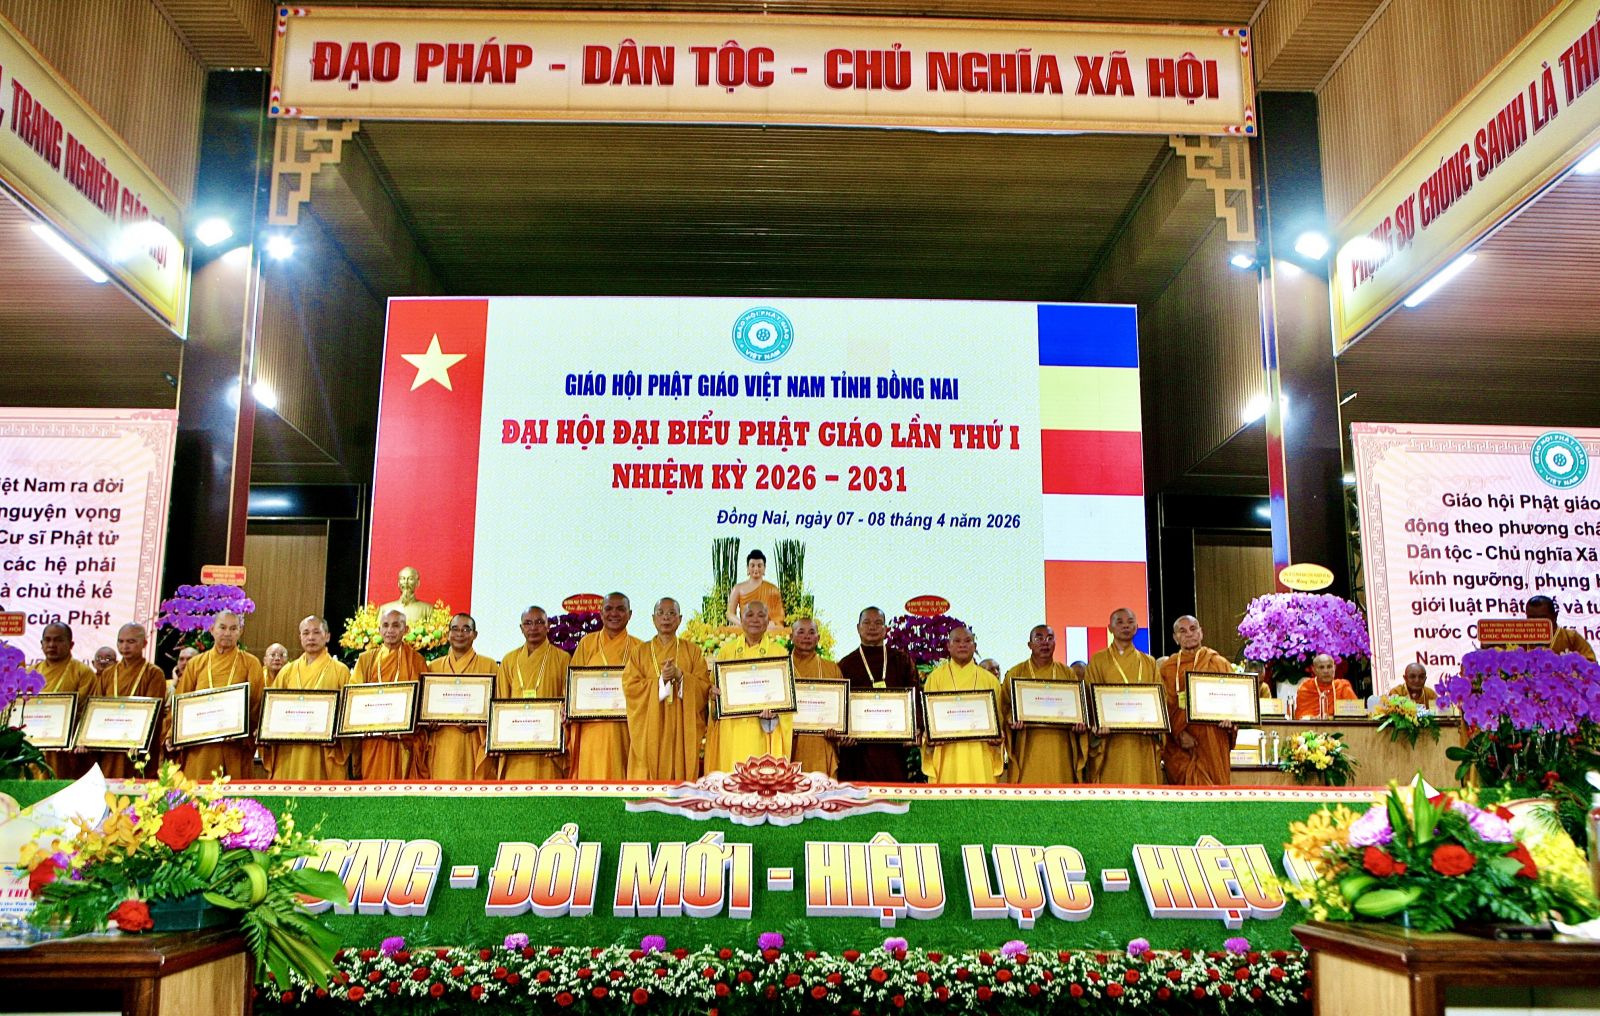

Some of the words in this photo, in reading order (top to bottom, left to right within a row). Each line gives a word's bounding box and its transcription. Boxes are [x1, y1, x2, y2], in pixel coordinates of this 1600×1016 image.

[310, 41, 400, 90] ĐẠO
[414, 36, 533, 85] PHÁP
[549, 63, 566, 71] -
[582, 37, 674, 87] DÂN
[690, 39, 774, 94] TỘC
[791, 66, 808, 75] -
[823, 42, 912, 91] CHỦ
[926, 47, 1063, 94] NGHĨA
[1075, 49, 1135, 96] XÃ
[1146, 51, 1219, 105] HỘI
[11, 76, 63, 172] TRANG
[64, 131, 119, 222] NGHIÊM
[1395, 192, 1417, 247] SỰ
[1418, 142, 1473, 230] CHÚNG
[1474, 92, 1528, 181] SANH
[1529, 60, 1559, 136] LÀ
[565, 370, 606, 396] GIÁO
[612, 370, 642, 400] HỘI
[648, 370, 692, 400] PHẬT
[698, 371, 739, 397] GIÁO
[744, 371, 781, 401] VIỆT
[787, 375, 825, 398] NAM
[831, 371, 871, 398] TỈNH
[877, 370, 924, 400] ĐỒNG
[930, 378, 959, 400] NAI
[501, 419, 549, 450] ĐẠI
[556, 413, 605, 450] HỘI
[612, 419, 660, 450] ĐẠI
[667, 410, 730, 445] BIỂU
[738, 415, 810, 452] PHẬT
[818, 417, 883, 447] GIÁO
[890, 413, 942, 449] LẦN
[950, 419, 1004, 450] THỨ
[1009, 425, 1020, 450] I
[0, 477, 19, 496] ệt
[24, 477, 65, 492] Nam
[71, 481, 88, 493] ra
[93, 478, 124, 493] đời
[612, 458, 703, 495] NHIỆM
[712, 458, 747, 490] KỲ
[755, 464, 816, 490] 2026
[848, 466, 907, 492] 2031
[0, 503, 66, 522] nguyện
[75, 507, 121, 523] vọng
[1442, 493, 1482, 508] Giáo
[1488, 494, 1514, 511] hội
[1520, 494, 1559, 512] Phật
[1564, 495, 1600, 513] giáo
[717, 507, 758, 528] Đồng
[762, 510, 790, 527] Nai,
[795, 510, 833, 529] ngày
[836, 511, 854, 526] 07
[868, 512, 885, 526] 08
[890, 512, 933, 530] tháng
[936, 513, 946, 527] 4
[950, 513, 981, 528] năm
[986, 514, 1021, 529] 2026
[1404, 518, 1449, 535] động
[1454, 519, 1493, 533] theo
[1499, 520, 1569, 538] phương
[0, 529, 24, 545] Cư
[28, 530, 47, 545] sĩ
[50, 530, 93, 548] Phật
[98, 530, 119, 545] tử
[1407, 544, 1441, 560] Dân
[1445, 546, 1472, 562] tộc
[1485, 545, 1520, 561] Chủ
[1525, 547, 1572, 564] nghĩa
[1576, 547, 1598, 562] Xã
[3, 556, 36, 571] các
[45, 556, 67, 575] hệ
[75, 557, 116, 575] phái
[0, 583, 10, 598] à
[16, 582, 51, 598] chủ
[57, 580, 86, 598] thể
[92, 580, 113, 598] kế
[1409, 570, 1446, 585] kính
[1453, 572, 1529, 590] ngưỡng,
[1535, 573, 1590, 591] phụng
[1411, 597, 1446, 615] giới
[1450, 598, 1483, 616] luật
[1486, 598, 1526, 616] Phật
[1563, 599, 1583, 614] và
[27, 609, 61, 625] của
[68, 610, 110, 629] Phật
[1414, 624, 1462, 639] nước
[1416, 651, 1460, 666] Nam.
[290, 838, 443, 916] ƠNG
[486, 823, 602, 917] ĐỔI
[614, 830, 753, 919] MỚI
[805, 832, 945, 928] HIỆU
[961, 844, 1093, 930] LỰC
[1132, 835, 1286, 930] HIỆU
